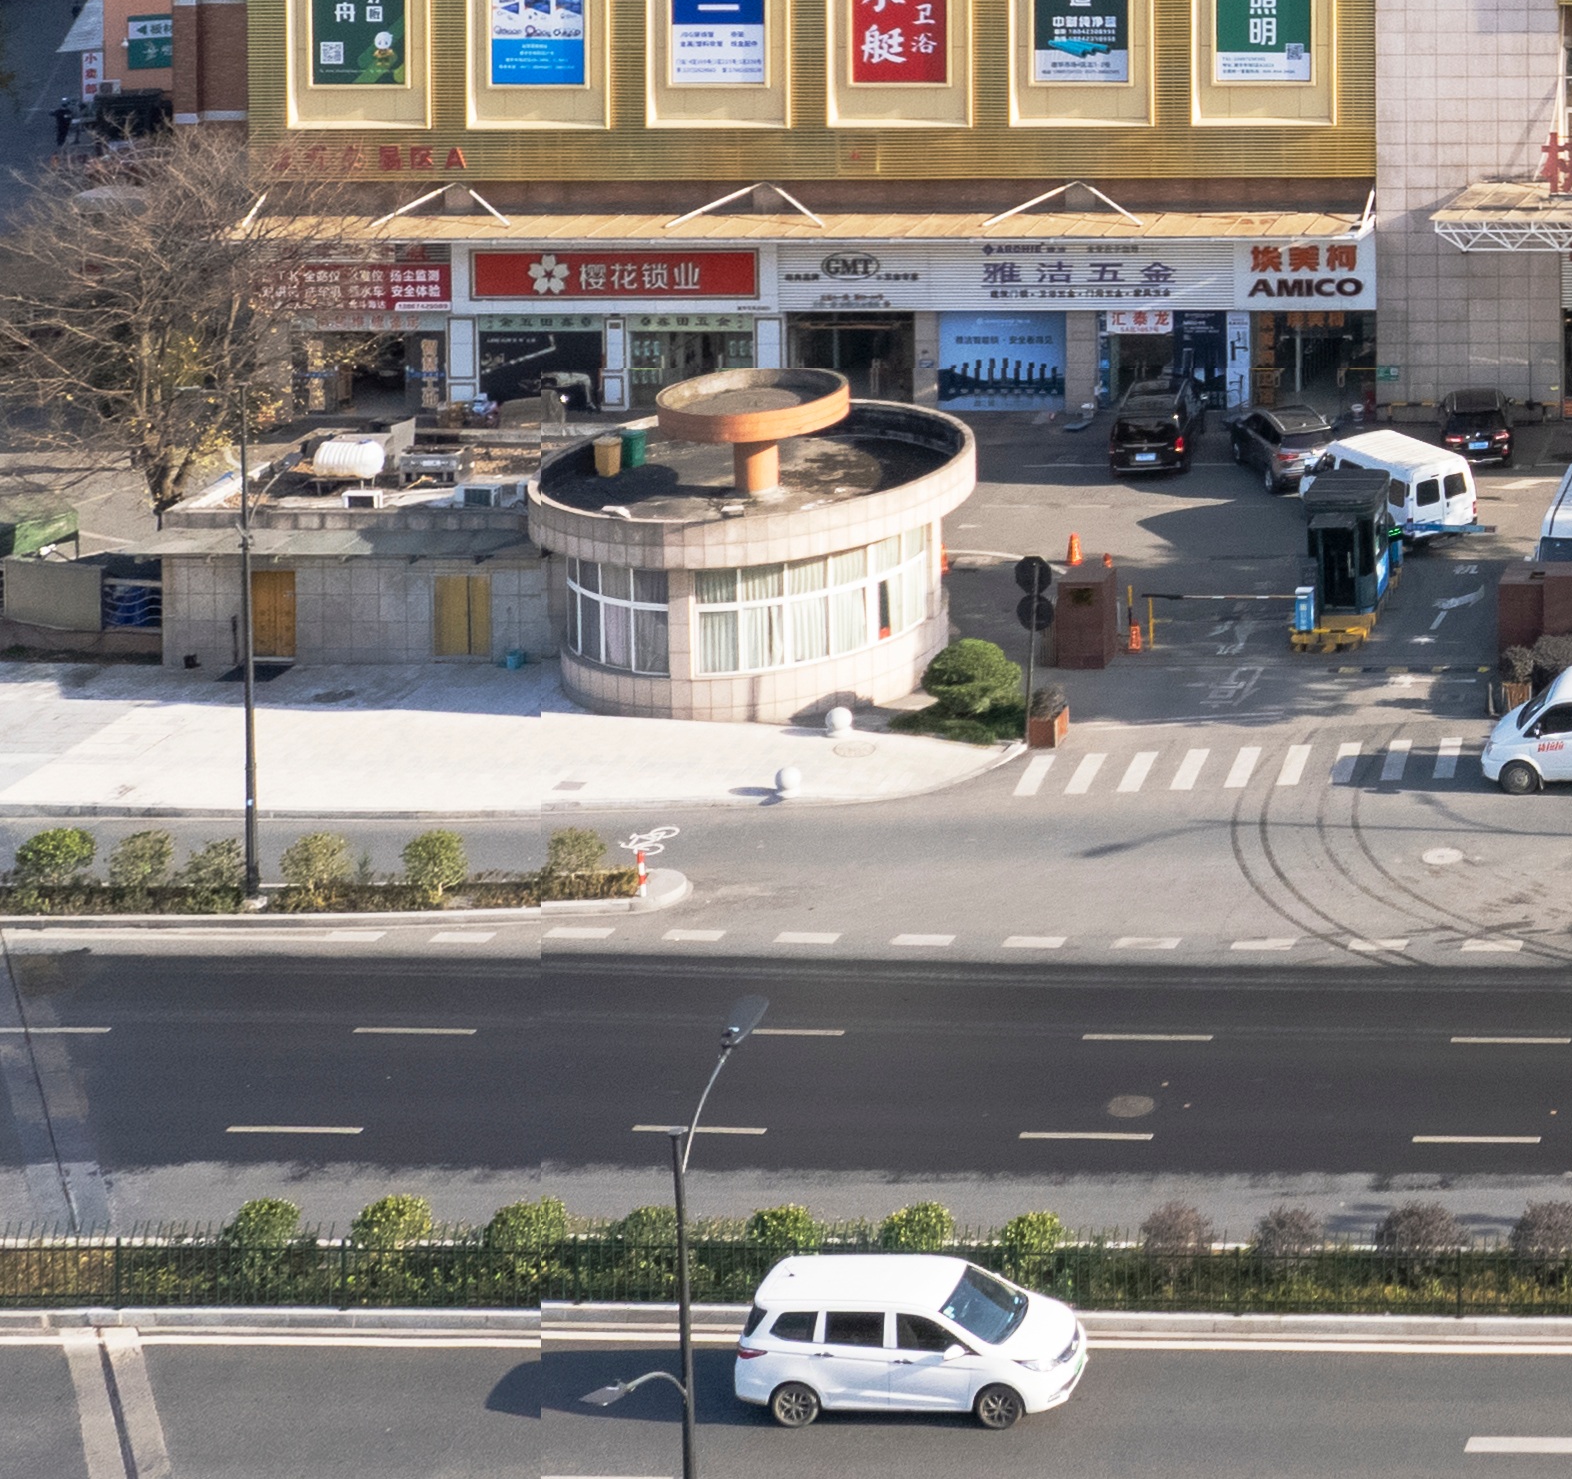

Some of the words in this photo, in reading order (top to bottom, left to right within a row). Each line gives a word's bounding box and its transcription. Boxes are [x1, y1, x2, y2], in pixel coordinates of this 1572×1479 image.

[825, 258, 873, 275] GMT
[1250, 244, 1358, 273] 埃美柯
[578, 263, 700, 291] 樱花锁业
[982, 261, 1177, 284] 雅洁五金
[391, 285, 441, 298] 安全体验
[1247, 277, 1364, 298] AMICO
[1110, 311, 1169, 326] 汇泰龙
